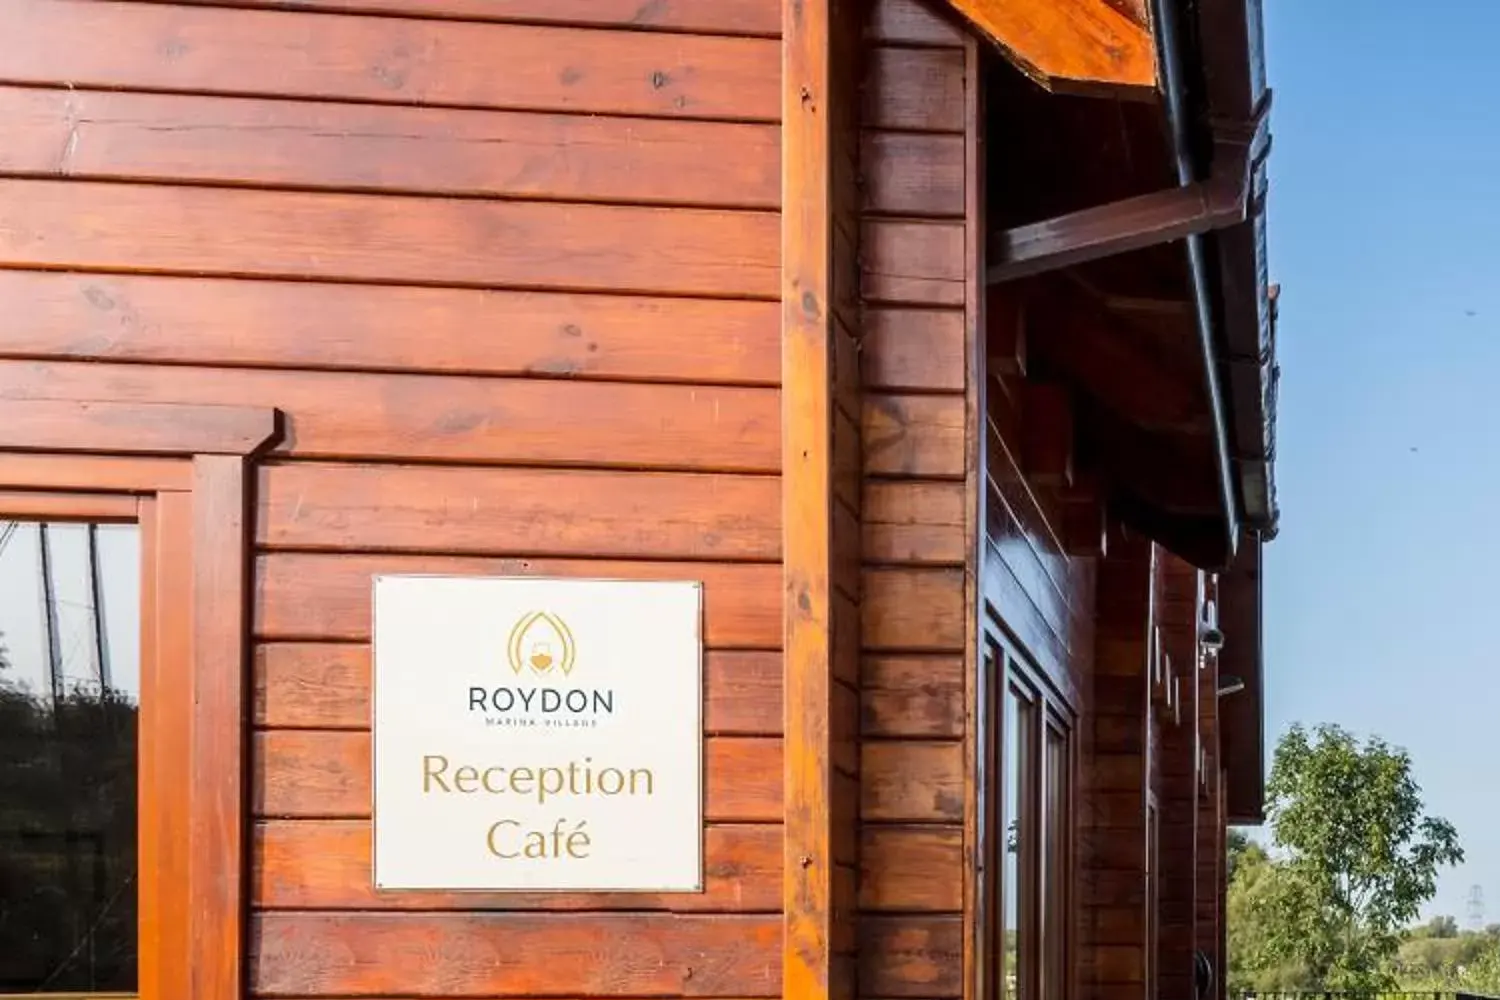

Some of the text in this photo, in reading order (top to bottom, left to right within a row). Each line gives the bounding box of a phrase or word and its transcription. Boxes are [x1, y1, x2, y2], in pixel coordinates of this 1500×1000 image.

[469, 687, 613, 714] ROYDON
[485, 718, 536, 726] MARINA
[423, 755, 653, 804] Reception
[487, 819, 591, 859] Café
